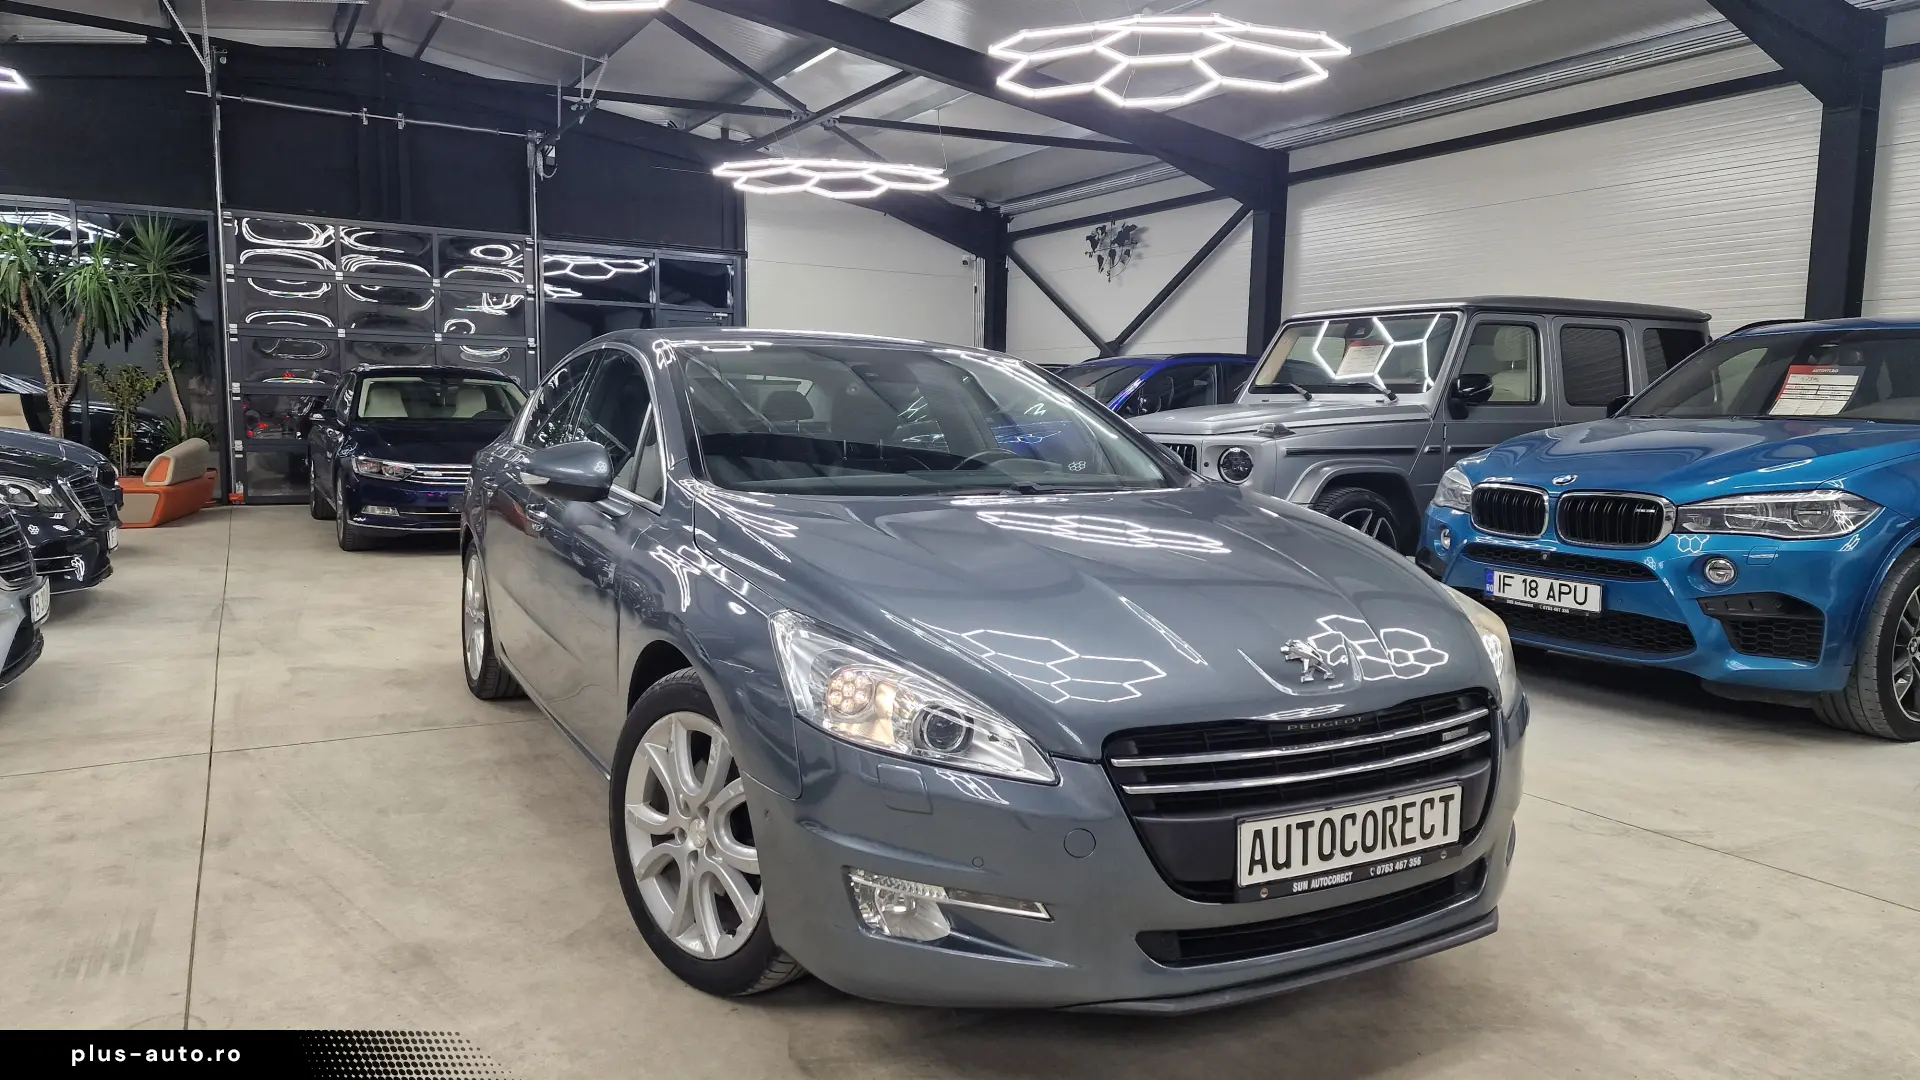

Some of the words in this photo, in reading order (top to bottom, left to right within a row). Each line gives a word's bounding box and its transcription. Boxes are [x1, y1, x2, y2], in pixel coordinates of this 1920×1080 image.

[1498, 574, 1514, 594] IF
[1522, 578, 1539, 599] 18
[1546, 582, 1589, 606] APU
[1287, 716, 1364, 731] PEUGEOT
[1248, 794, 1455, 876] AUTOCORECT
[1292, 880, 1308, 893] SUN
[1311, 871, 1353, 890] AUTOCORECT
[1376, 862, 1394, 875] 0763
[1394, 860, 1409, 872] 467
[1409, 856, 1422, 869] 356
